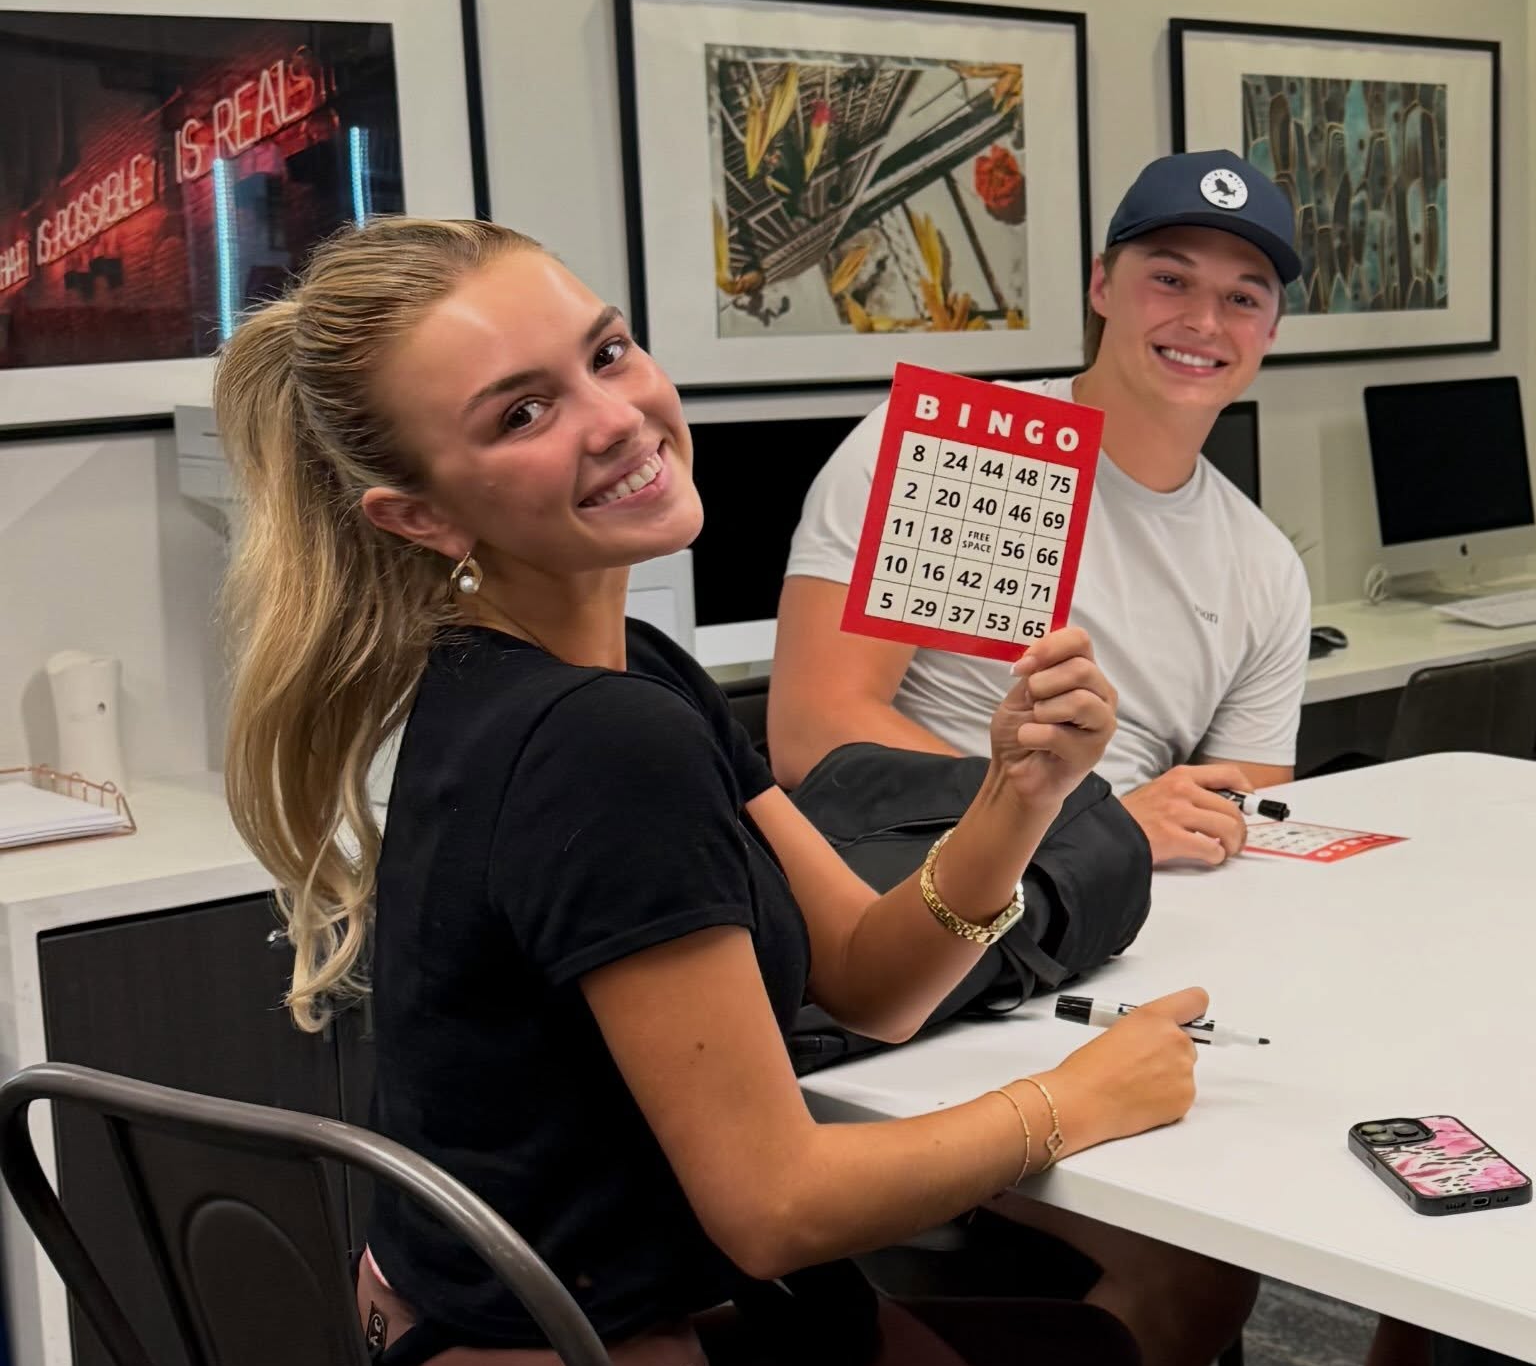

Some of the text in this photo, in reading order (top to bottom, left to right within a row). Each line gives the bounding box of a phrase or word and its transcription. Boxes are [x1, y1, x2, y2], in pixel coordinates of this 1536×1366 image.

[174, 118, 203, 183] IS
[212, 59, 302, 160] REAL
[915, 394, 1079, 452] BINGO
[913, 445, 1070, 493] 8 24 44 48 75
[904, 483, 1064, 529] 2 20 40 46 69
[893, 519, 1058, 566] 11 18 FREE 56 66
[962, 540, 992, 553] SPACE
[885, 556, 1050, 602] 10 16 42 49 71
[880, 593, 1045, 638] 5 29 37 53 65
